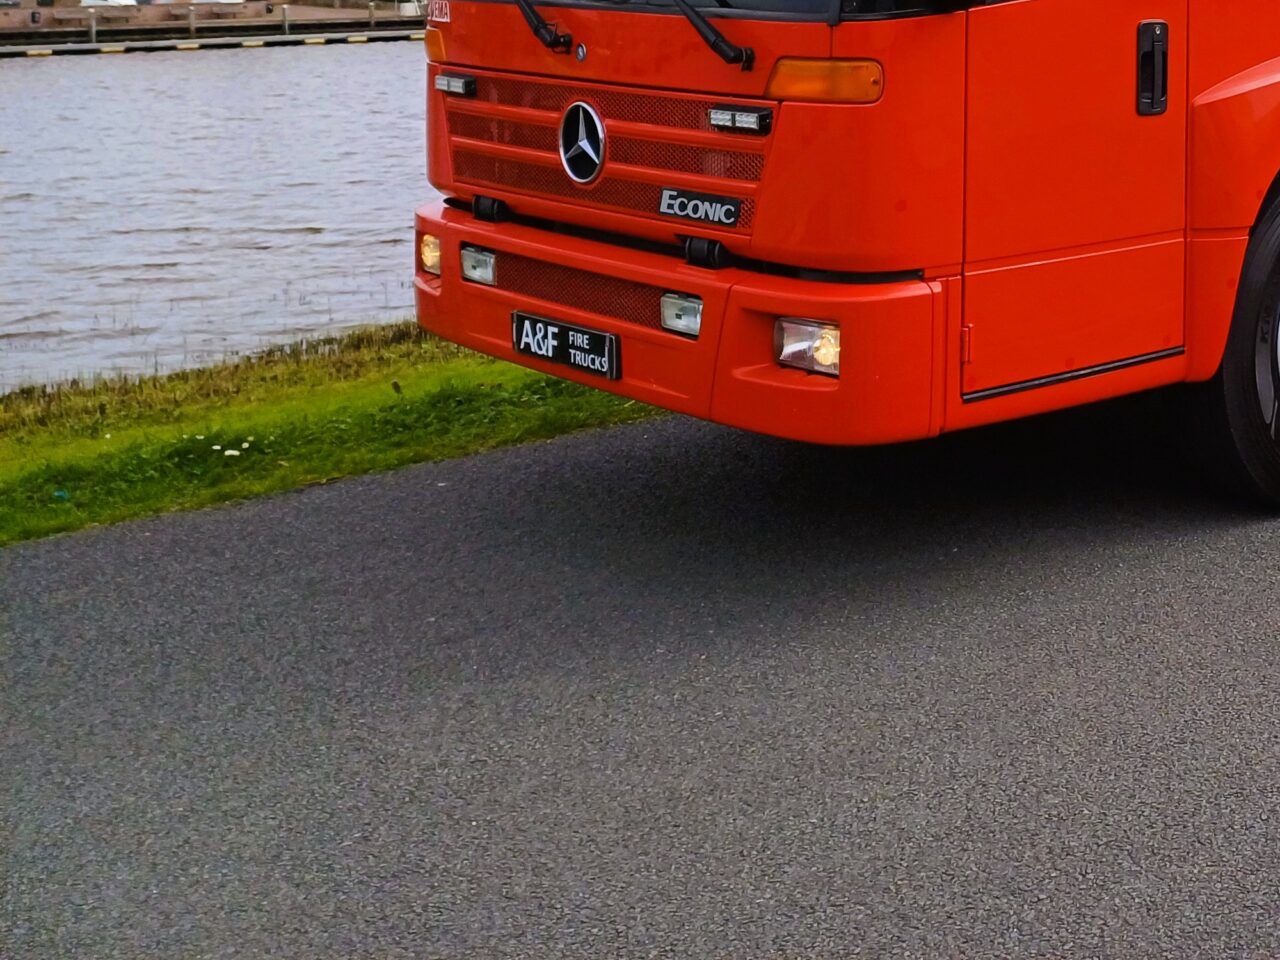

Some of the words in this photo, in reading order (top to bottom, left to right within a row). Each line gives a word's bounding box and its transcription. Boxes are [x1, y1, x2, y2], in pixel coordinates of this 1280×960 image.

[520, 320, 559, 357] A&F
[568, 331, 591, 349] FIRE
[568, 348, 610, 372] TRUCKS
